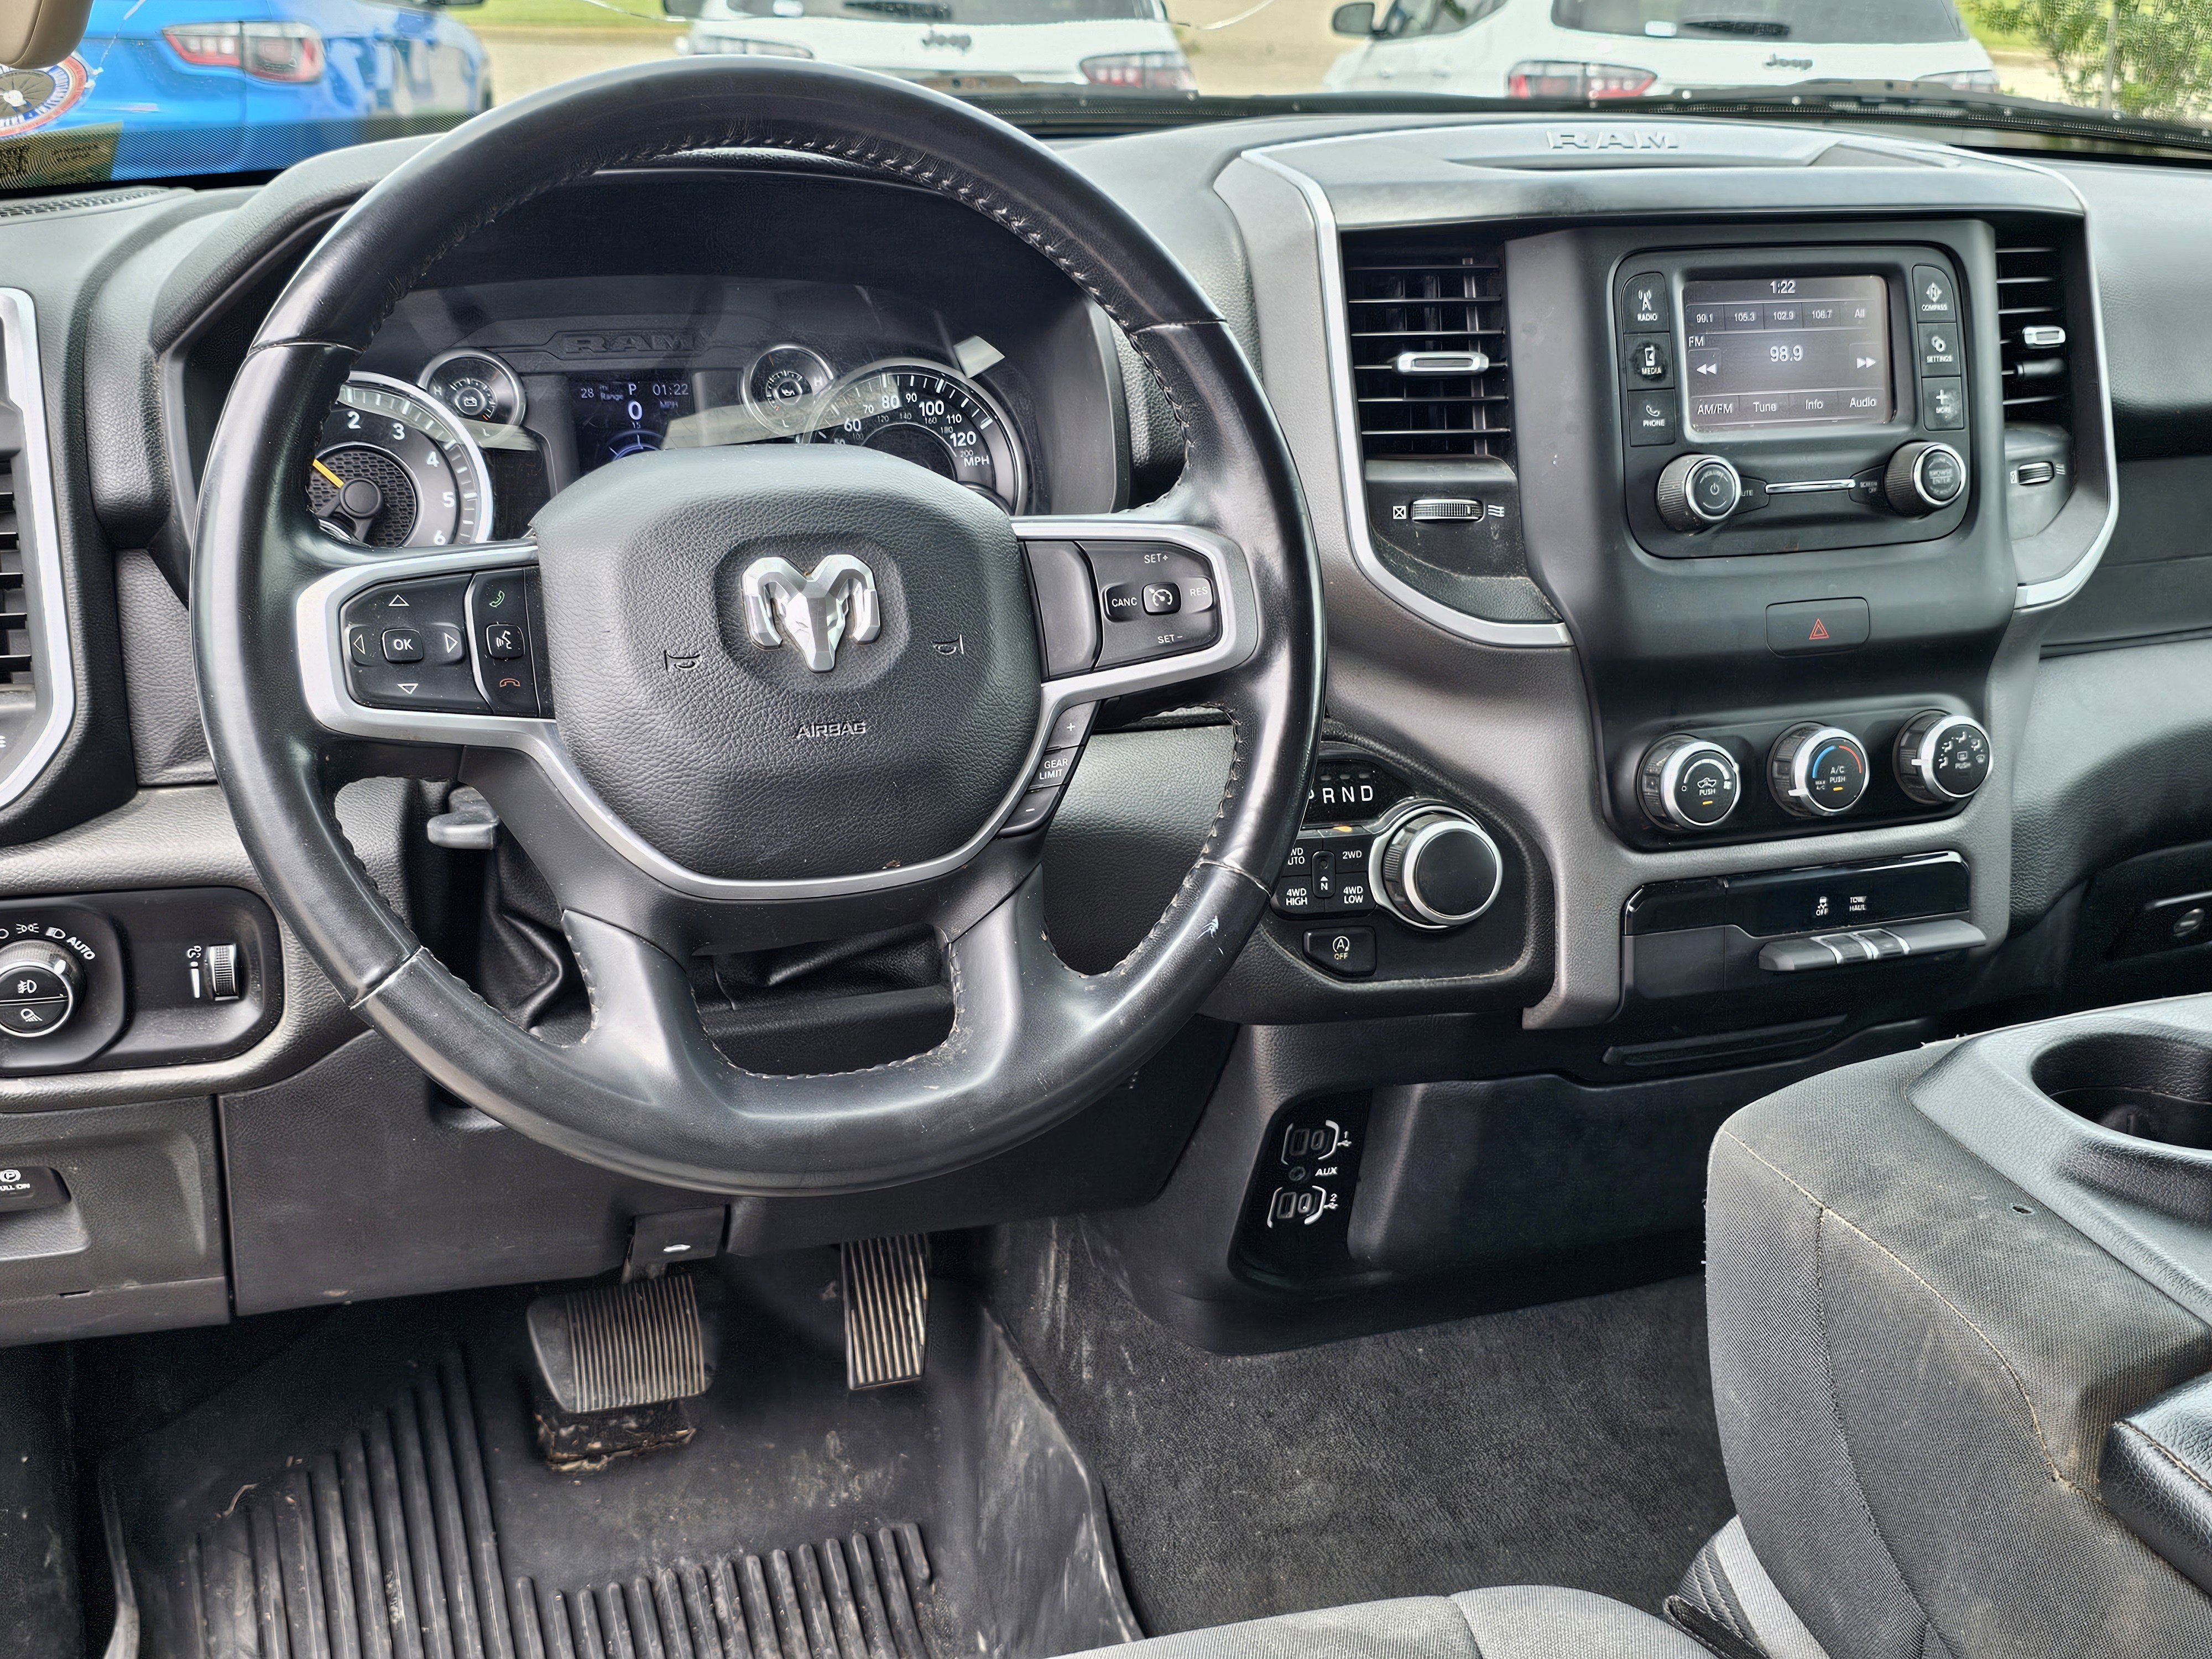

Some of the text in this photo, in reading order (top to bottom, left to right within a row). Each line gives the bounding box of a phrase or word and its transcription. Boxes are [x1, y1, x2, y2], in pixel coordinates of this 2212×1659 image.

[1765, 53, 1813, 71] Jeep
[1546, 131, 1678, 149] RAM
[1770, 280, 1796, 294] 1:22
[1637, 313, 1658, 321] RADIO
[1854, 308, 1865, 319] All
[563, 333, 695, 353] RAM
[1688, 336, 1704, 347] FM
[1770, 345, 1803, 362] 98.9
[1641, 367, 1662, 375] MEDIA
[581, 388, 594, 399] 28
[629, 383, 637, 395] P
[653, 383, 688, 396] 01:22
[881, 395, 900, 409] 80
[905, 393, 917, 403] 90
[1849, 397, 1876, 408] Audio
[628, 400, 643, 420] 0
[863, 404, 874, 414] 70
[919, 400, 945, 416] 100
[1697, 403, 1733, 415] AM/FM
[1752, 401, 1777, 413] Tune
[1805, 399, 1823, 410] Info
[347, 410, 361, 429] 2
[946, 413, 962, 424] 110
[1642, 419, 1665, 427] PHONE
[844, 418, 862, 432] 60
[393, 422, 405, 440] 3
[949, 430, 977, 447] 120
[426, 451, 440, 467] 4
[963, 455, 989, 467] MPH
[443, 492, 455, 508] 5
[434, 530, 446, 545] 6
[1190, 586, 1208, 597] RES
[1112, 597, 1138, 607] CANC
[393, 638, 413, 651] OK
[795, 721, 867, 740] AIRBAG
[1044, 758, 1068, 769] GEAR
[1039, 769, 1063, 780] LIMIT
[1830, 765, 1845, 774] A/C
[1699, 787, 1716, 796] PUSH
[1290, 847, 1303, 856] WD
[1342, 850, 1362, 859] 2WD
[1287, 856, 1305, 865] UTO
[1286, 888, 1307, 896] 4WD
[1343, 886, 1363, 894] 4WD
[1286, 897, 1307, 905] HIGH
[1344, 895, 1363, 904] LOW
[66, 936, 96, 960] AUTO
[1315, 1166, 1338, 1176] AUX
